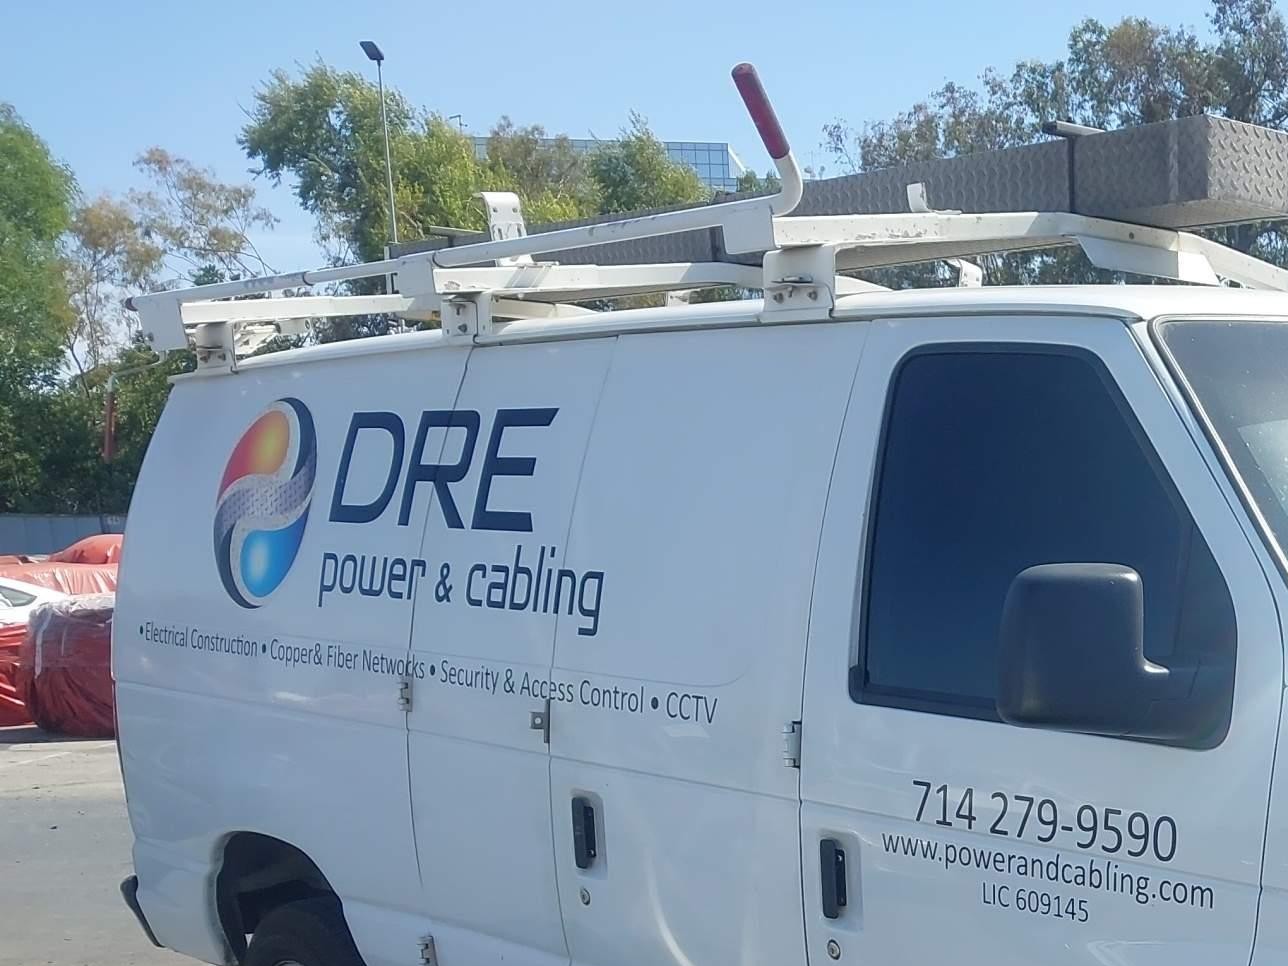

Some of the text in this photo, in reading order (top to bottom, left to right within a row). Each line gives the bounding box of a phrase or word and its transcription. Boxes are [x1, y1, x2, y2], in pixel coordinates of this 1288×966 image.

[328, 407, 559, 532] DRE
[318, 544, 605, 636] power & cabling
[144, 621, 188, 647] Electrical
[190, 628, 258, 657] Construction
[326, 644, 359, 670] Fiber
[362, 649, 425, 680] Networks
[439, 659, 499, 695] Security
[503, 668, 515, 694] &
[519, 671, 574, 703] Access
[579, 679, 644, 713] Control
[666, 691, 718, 724] CCTV
[912, 779, 1178, 862] 714 279-9590
[881, 832, 1215, 909] www.powerandcabling.com
[981, 881, 1090, 922] LIC 609145
